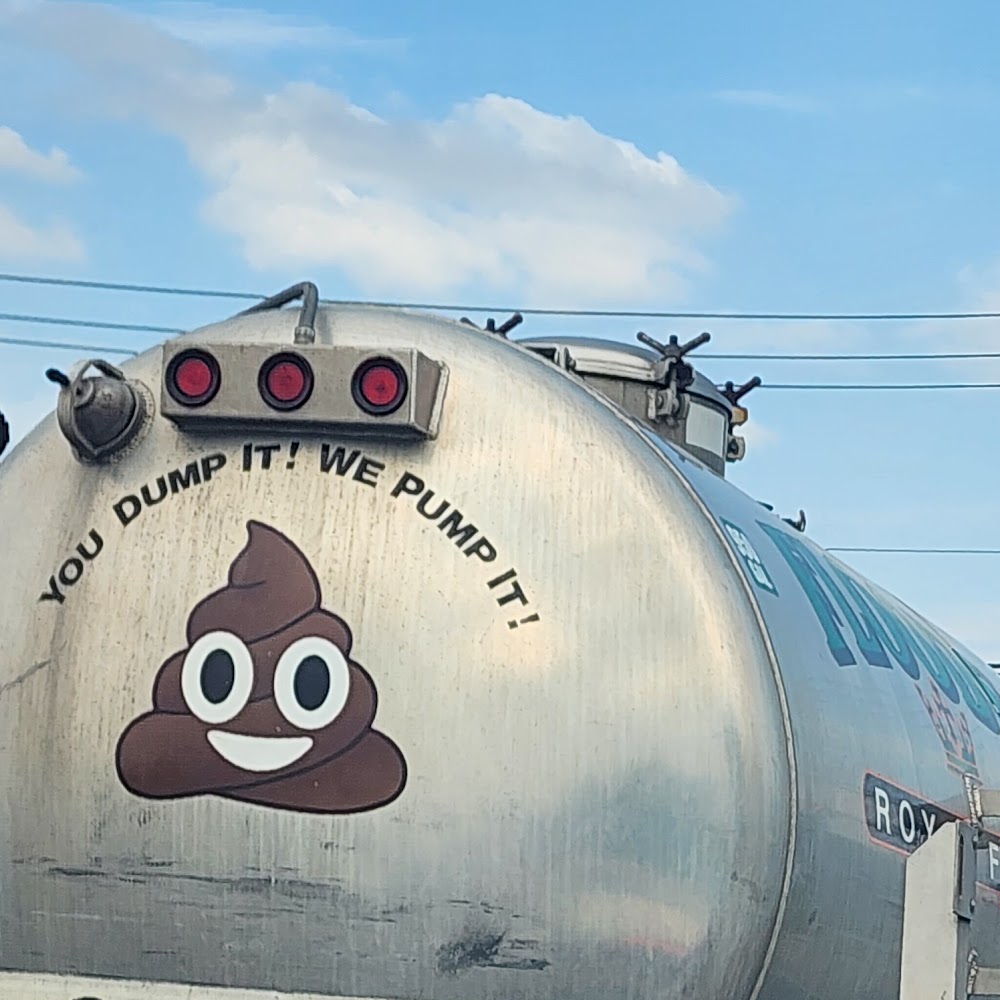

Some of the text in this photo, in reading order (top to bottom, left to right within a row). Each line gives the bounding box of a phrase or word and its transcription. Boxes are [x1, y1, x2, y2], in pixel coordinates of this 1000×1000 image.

[38, 441, 541, 630] YOU DUMP IT! WE PUMP IT!
[874, 786, 937, 844] ROY
